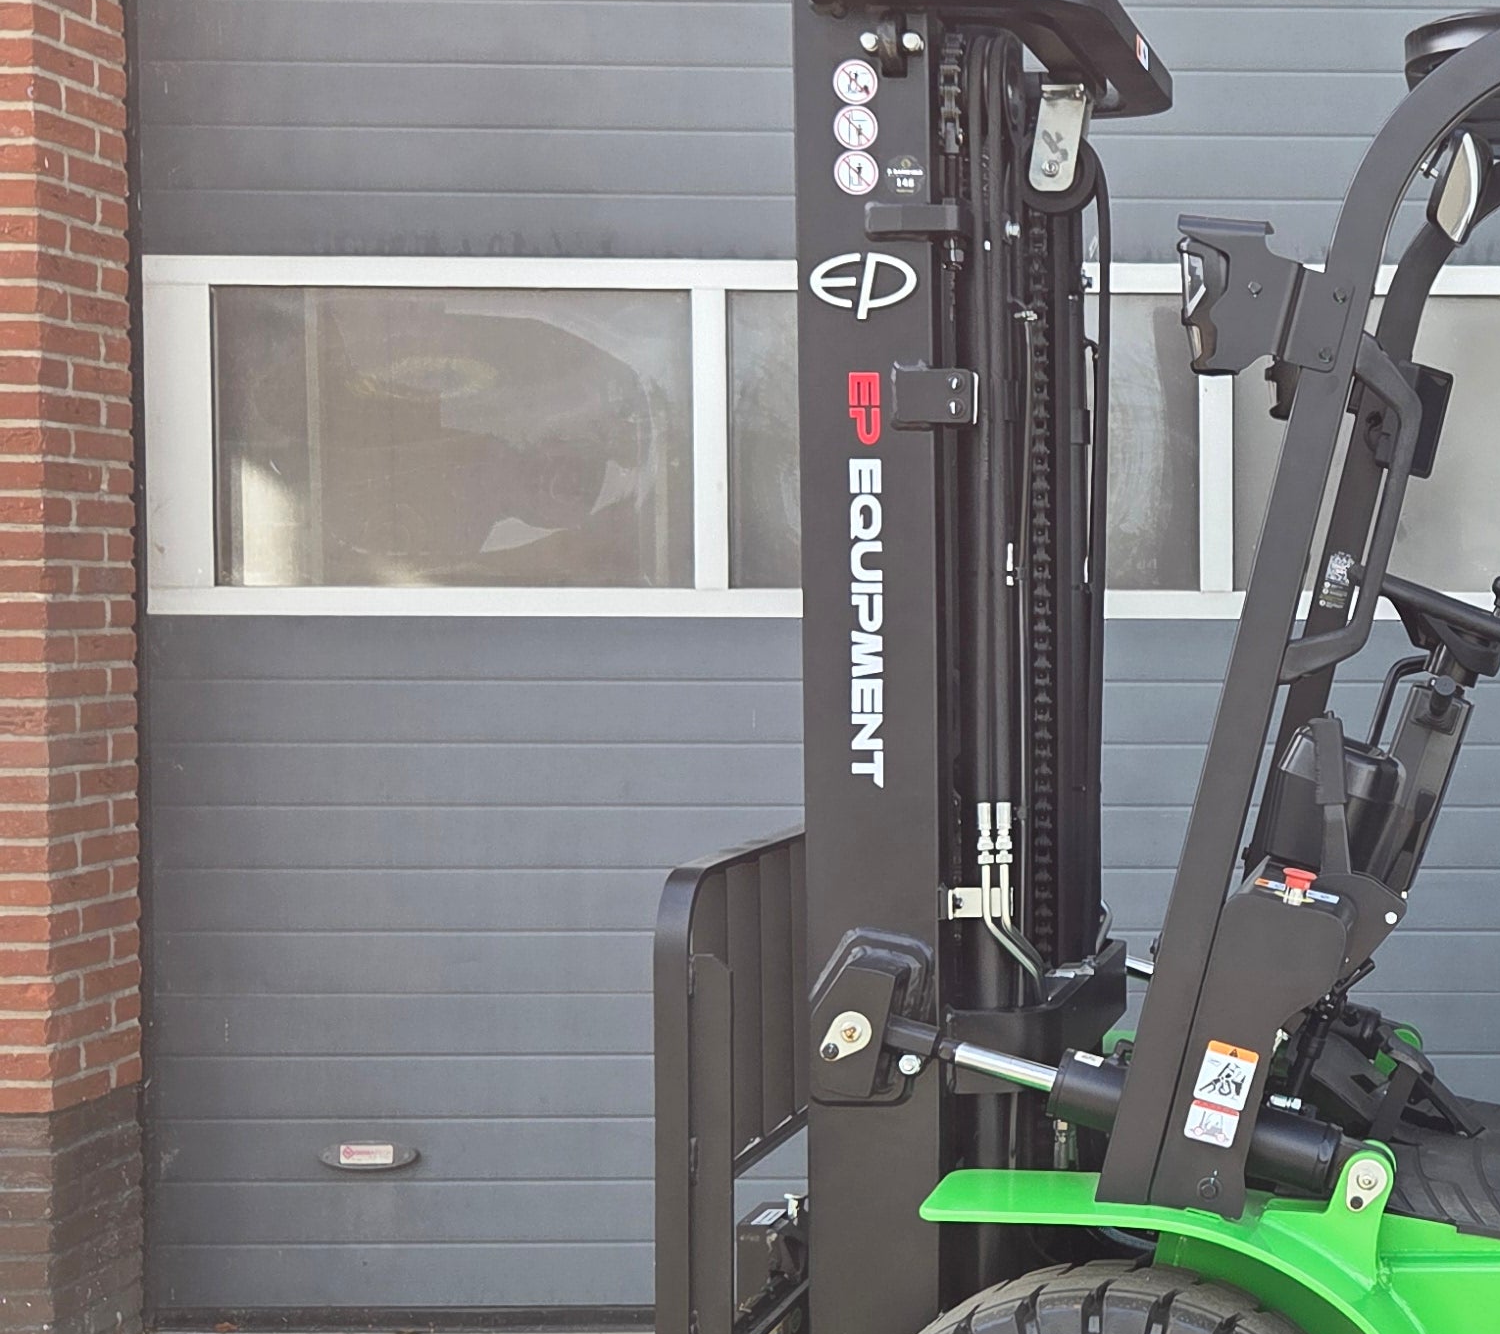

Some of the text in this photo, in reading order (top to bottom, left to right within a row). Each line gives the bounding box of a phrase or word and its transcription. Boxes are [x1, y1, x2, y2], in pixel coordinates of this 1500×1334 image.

[809, 252, 918, 319] EP
[848, 371, 884, 788] EP EQUIPMENT
